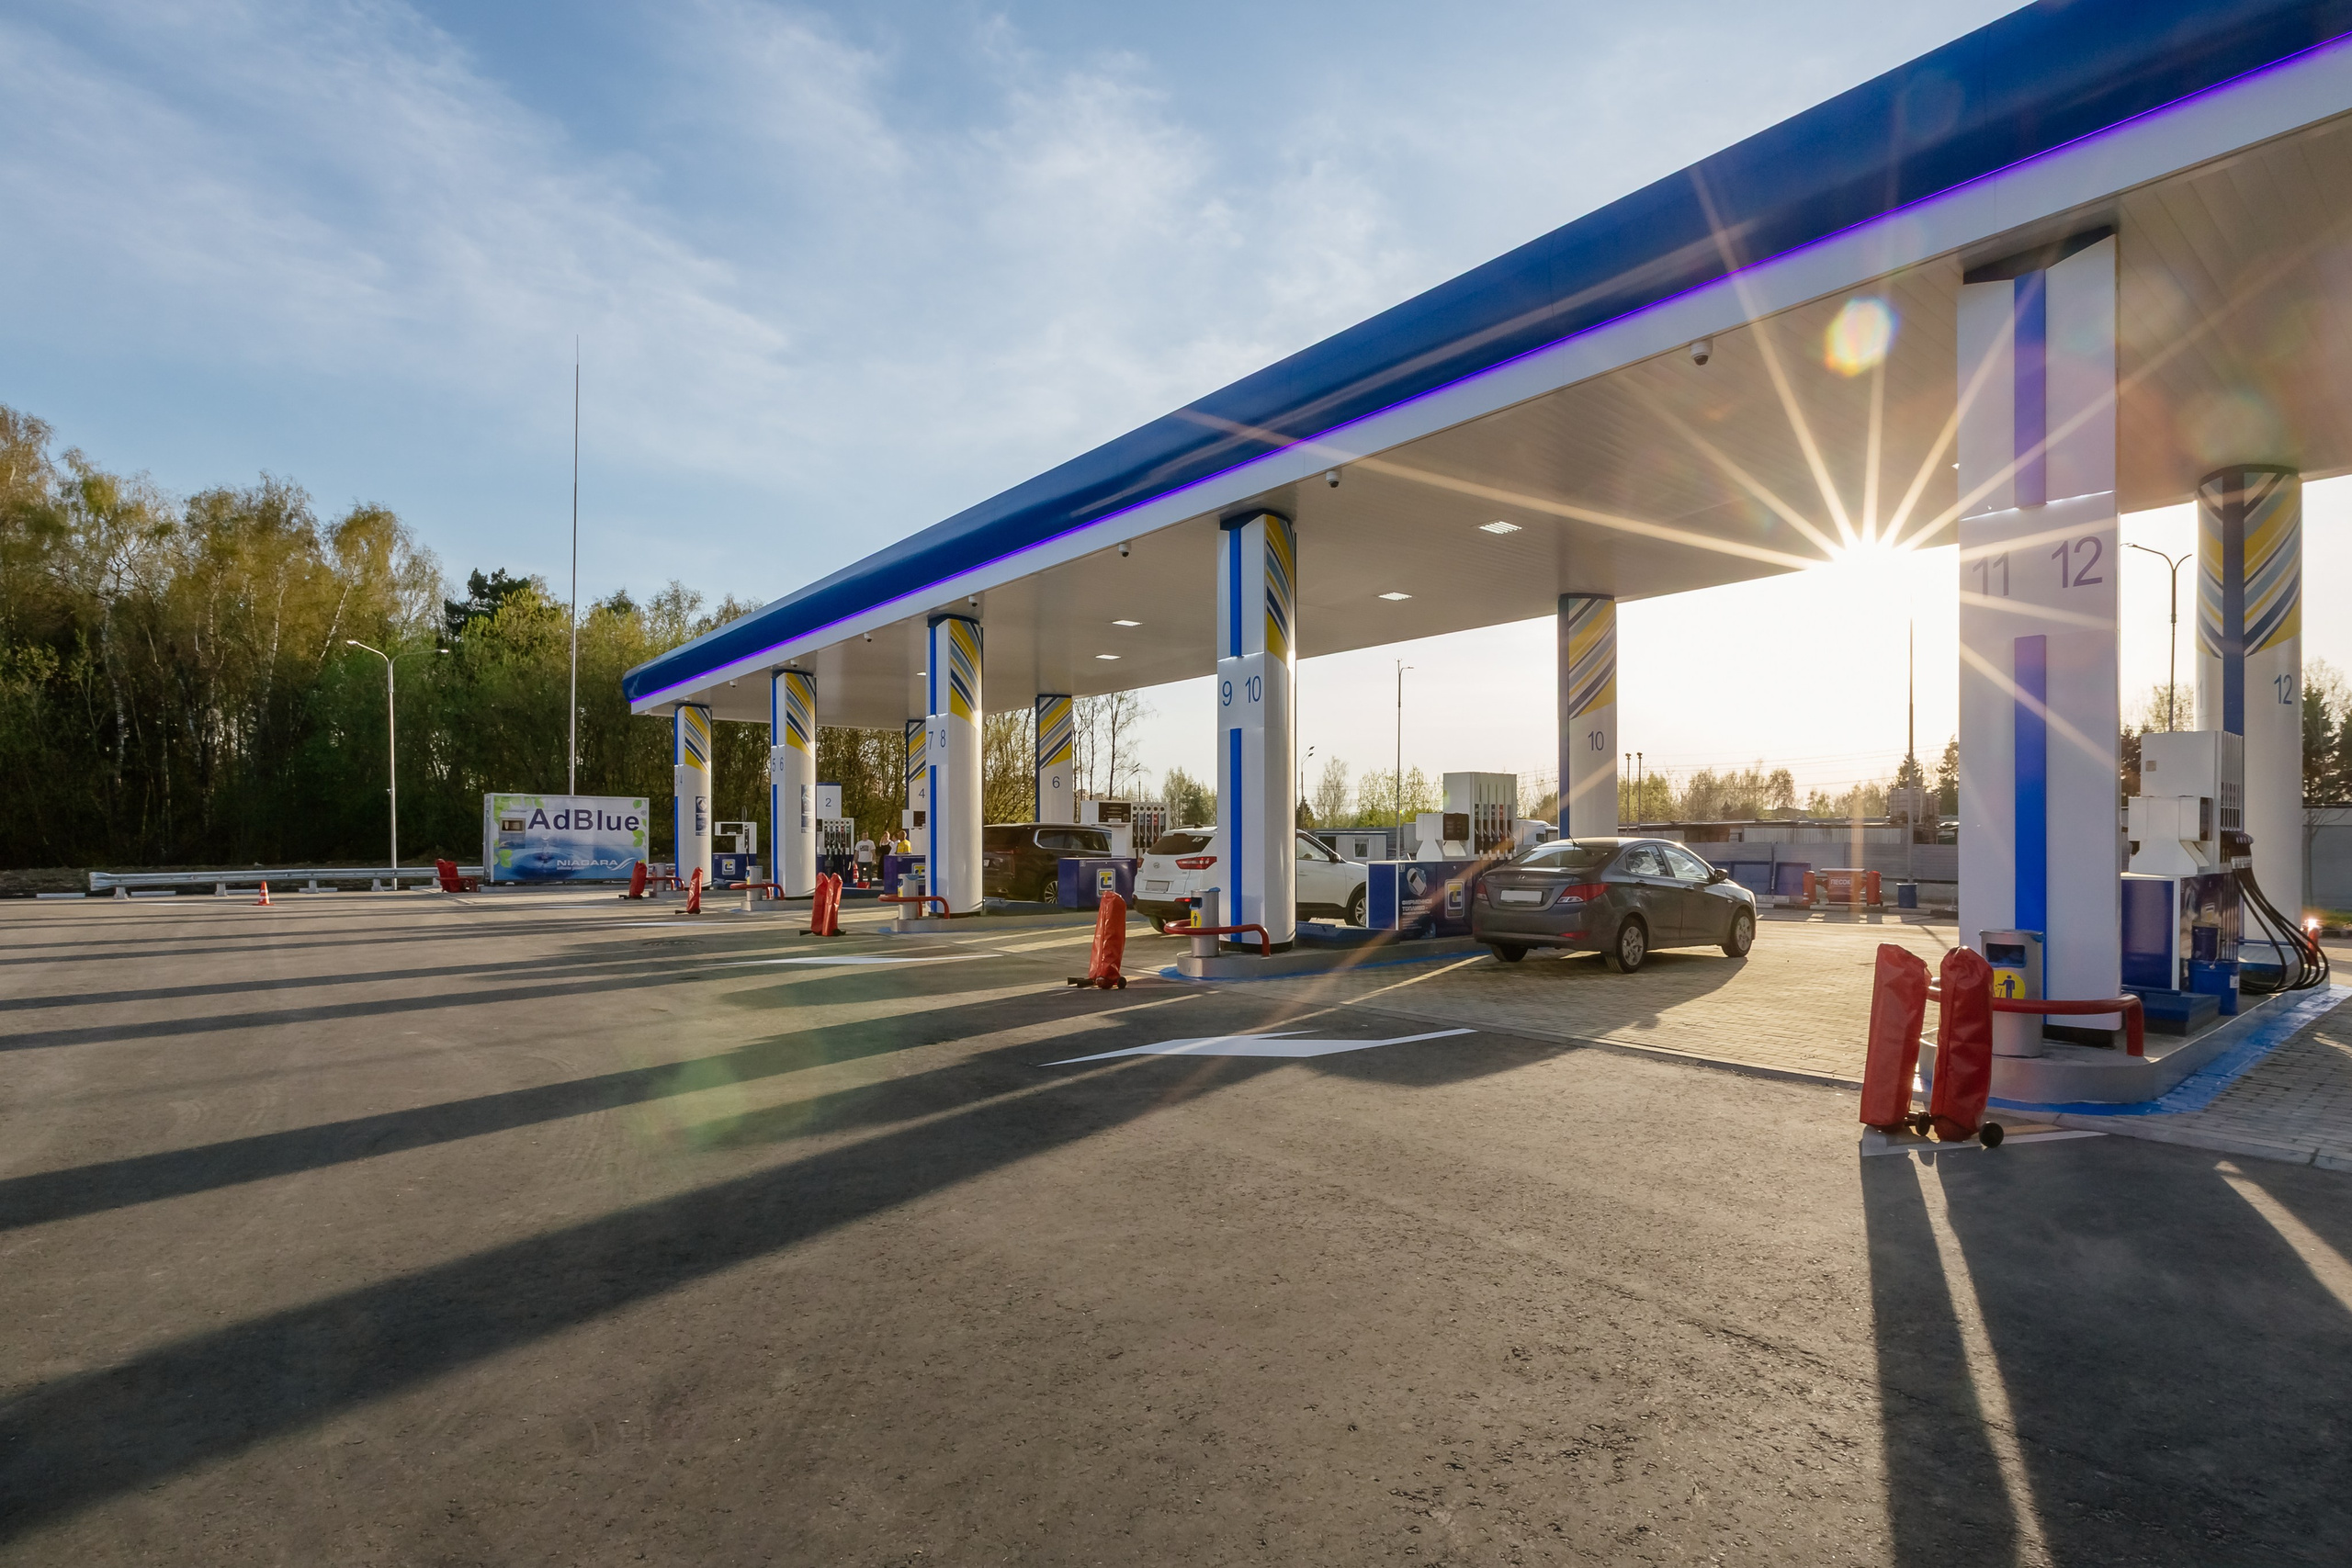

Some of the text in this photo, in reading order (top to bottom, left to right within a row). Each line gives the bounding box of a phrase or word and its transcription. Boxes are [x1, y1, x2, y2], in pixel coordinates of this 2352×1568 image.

[1972, 536, 2103, 596] 11 12
[1222, 675, 1261, 706] 9 10
[2273, 673, 2293, 705] 12
[928, 728, 946, 750] 7 8
[1588, 730, 1605, 751] 10
[779, 756, 785, 772] 6
[1052, 775, 1060, 789] 6
[825, 797, 831, 807] 2
[918, 787, 926, 799] 4
[527, 807, 639, 831] AdBlue
